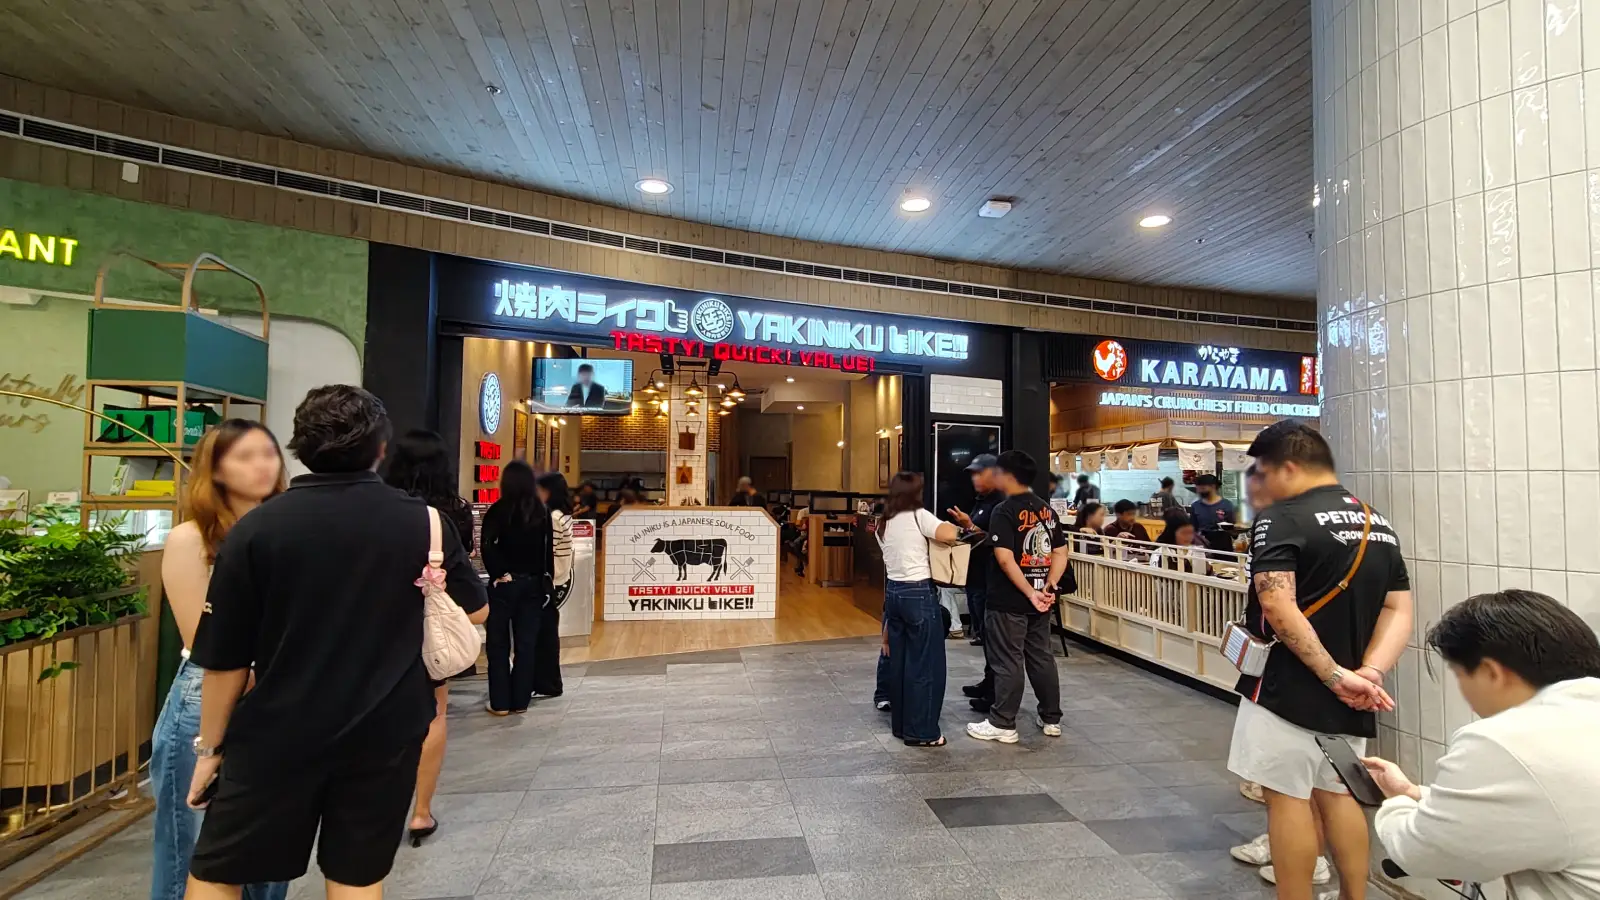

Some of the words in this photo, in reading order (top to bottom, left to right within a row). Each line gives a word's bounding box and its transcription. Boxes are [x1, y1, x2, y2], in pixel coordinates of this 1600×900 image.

[0, 229, 78, 266] ANT
[494, 279, 665, 332] 焼肉ライク
[738, 310, 884, 352] YAKINIKU
[610, 330, 704, 358] TASTY!
[714, 343, 791, 365] QUICK!
[800, 350, 875, 371] VALUE!
[1198, 345, 1241, 364] からやま
[1141, 359, 1288, 392] KARAYAMA
[1154, 396, 1234, 413] CRUNCHIEST
[663, 520, 670, 528] IS
[679, 517, 714, 526] JAPANESE
[715, 519, 734, 531] SOUL
[735, 525, 756, 541] FOOD
[632, 587, 671, 595] TASTY!
[675, 586, 711, 594] QUICK!
[712, 585, 752, 593] VALUE!
[628, 598, 704, 611] YAKINIKU
